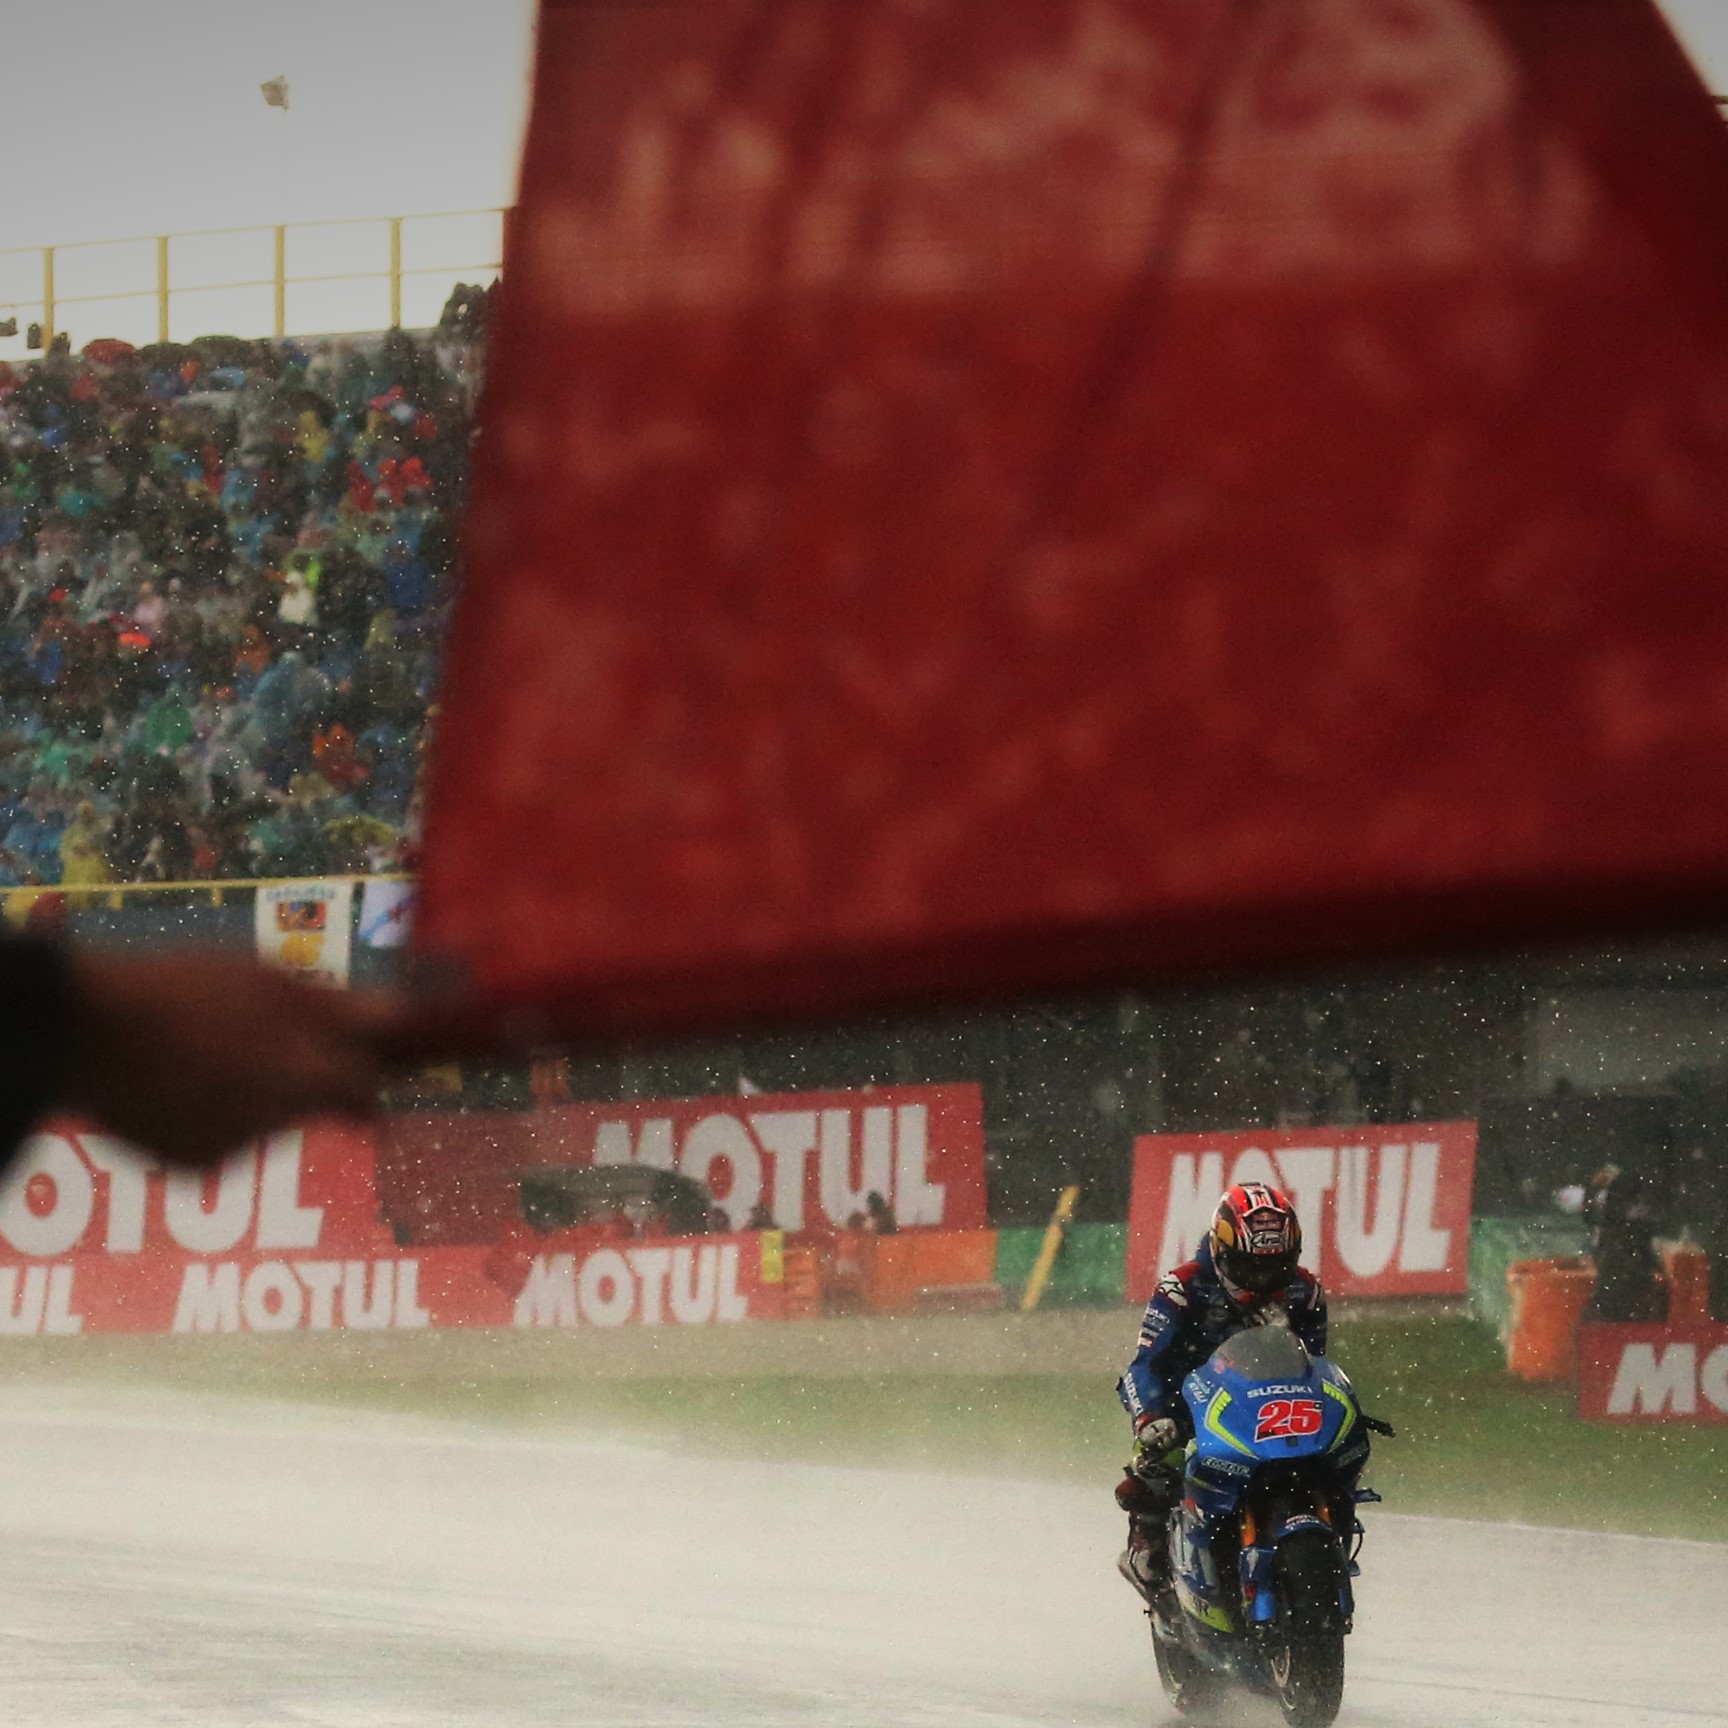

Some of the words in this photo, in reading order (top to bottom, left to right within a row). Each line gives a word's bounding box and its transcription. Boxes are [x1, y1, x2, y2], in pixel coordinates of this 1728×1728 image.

[174, 1258, 430, 1334] MOTUL
[513, 1244, 749, 1327] MOTUL
[1246, 1384, 1314, 1399] SUZUKI
[1254, 1399, 1324, 1443] 25
